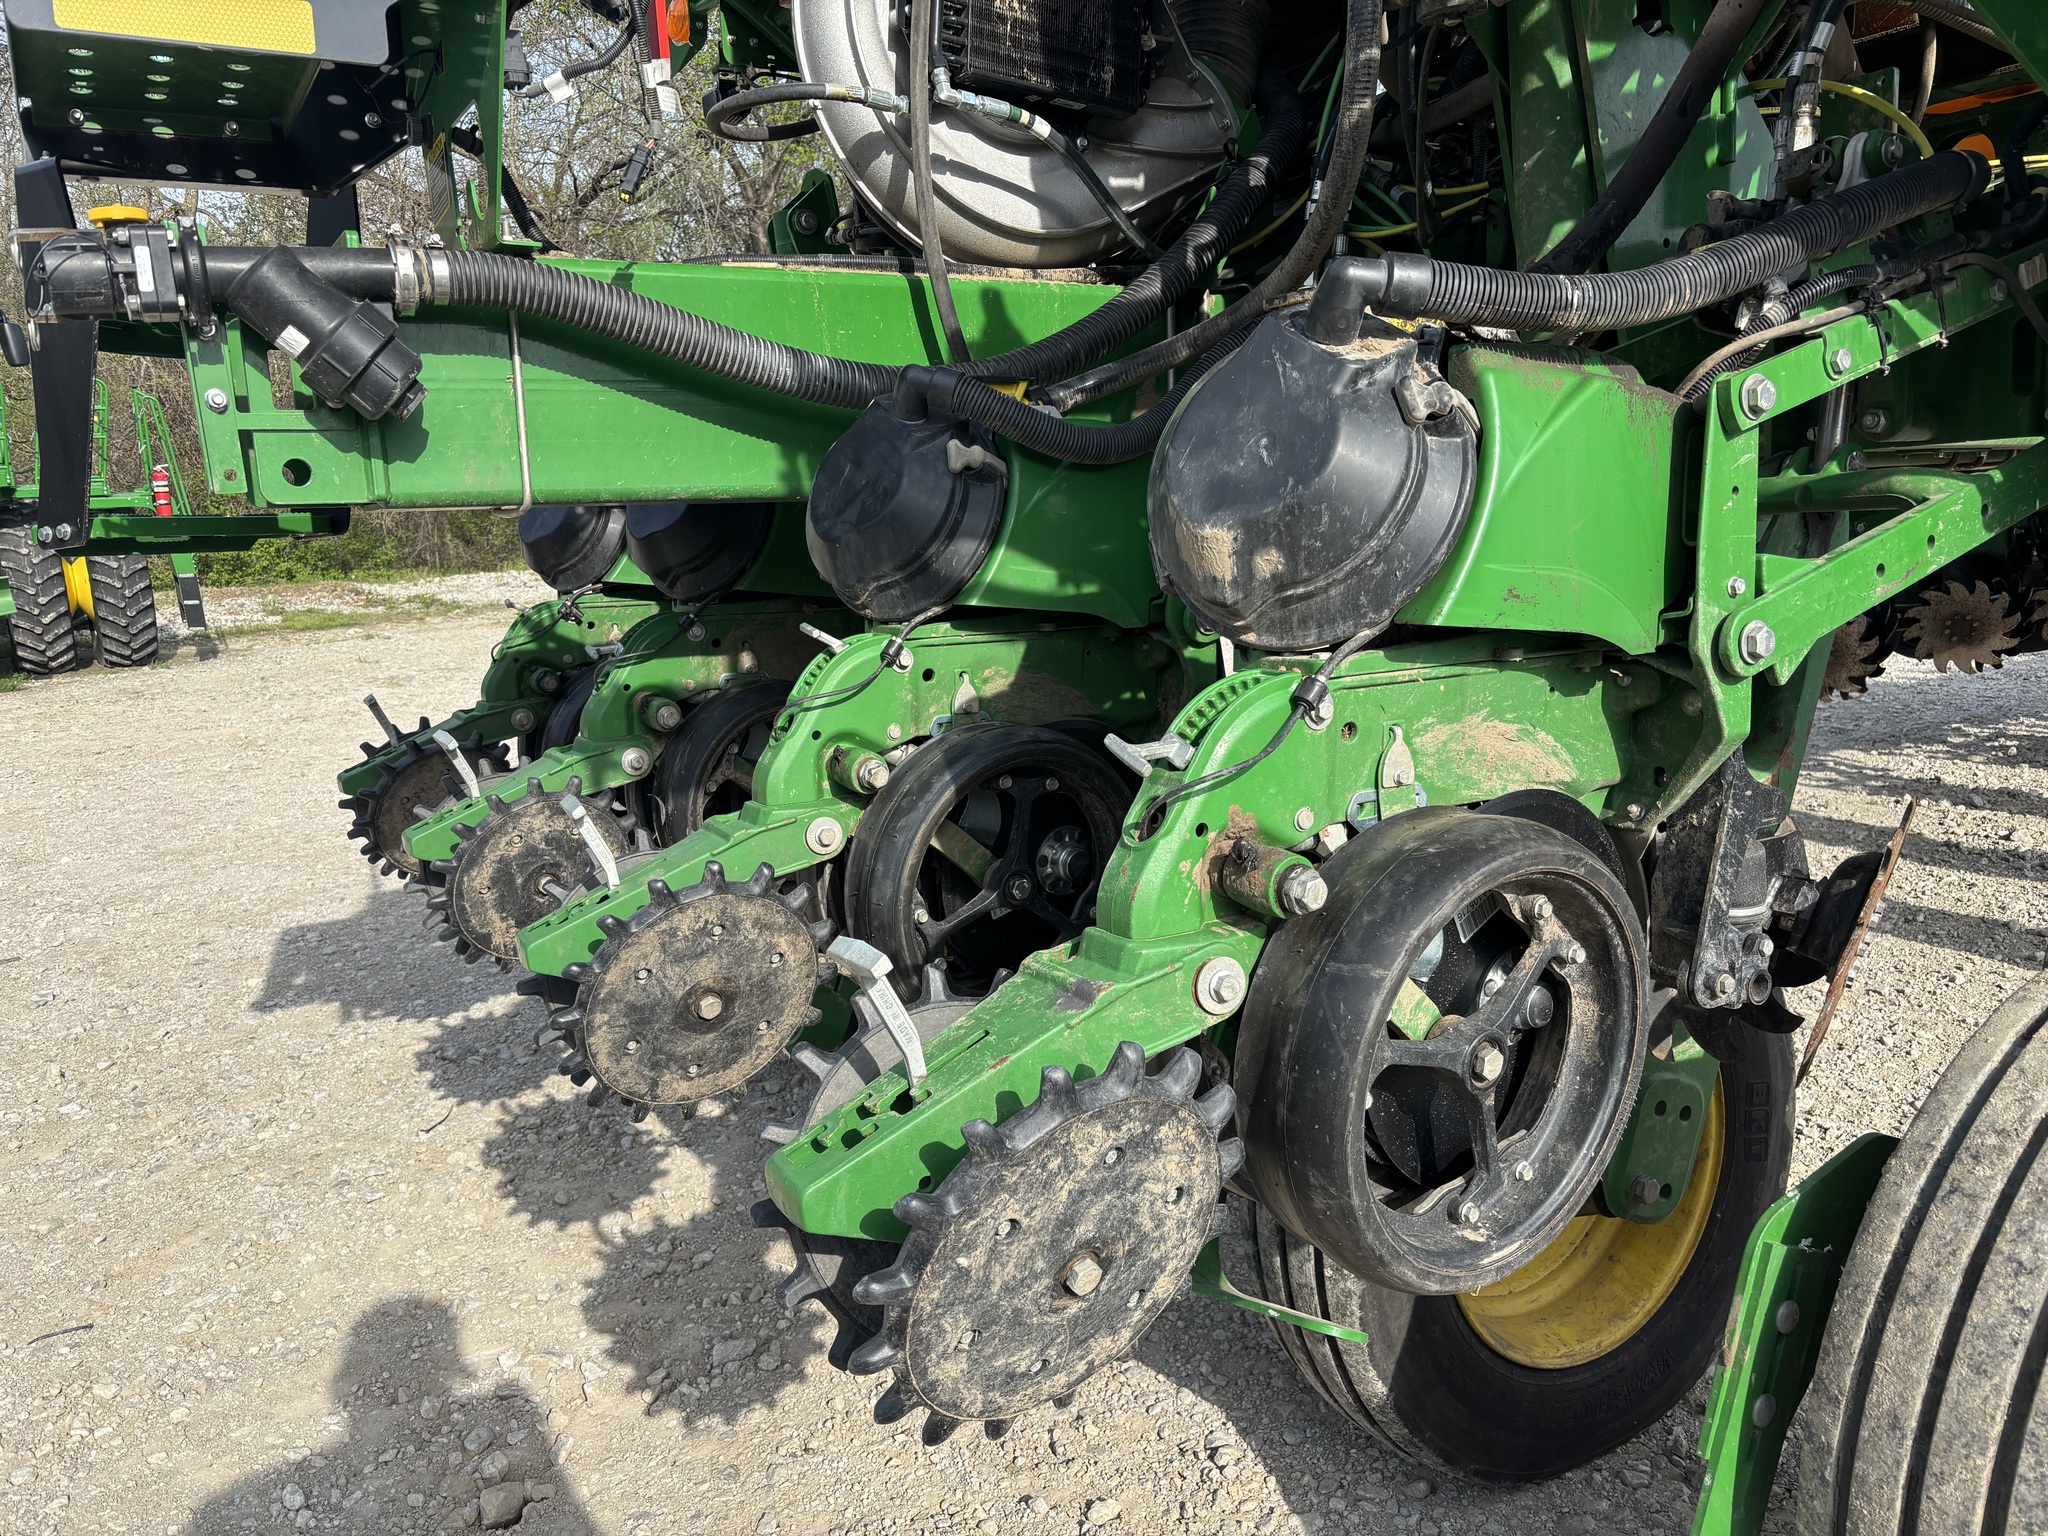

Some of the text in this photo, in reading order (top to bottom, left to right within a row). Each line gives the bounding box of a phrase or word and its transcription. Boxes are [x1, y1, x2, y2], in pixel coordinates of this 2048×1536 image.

[875, 987, 895, 1010] CHINA
[897, 1022, 914, 1044] MADE
[1747, 1082, 1769, 1163] BKT
